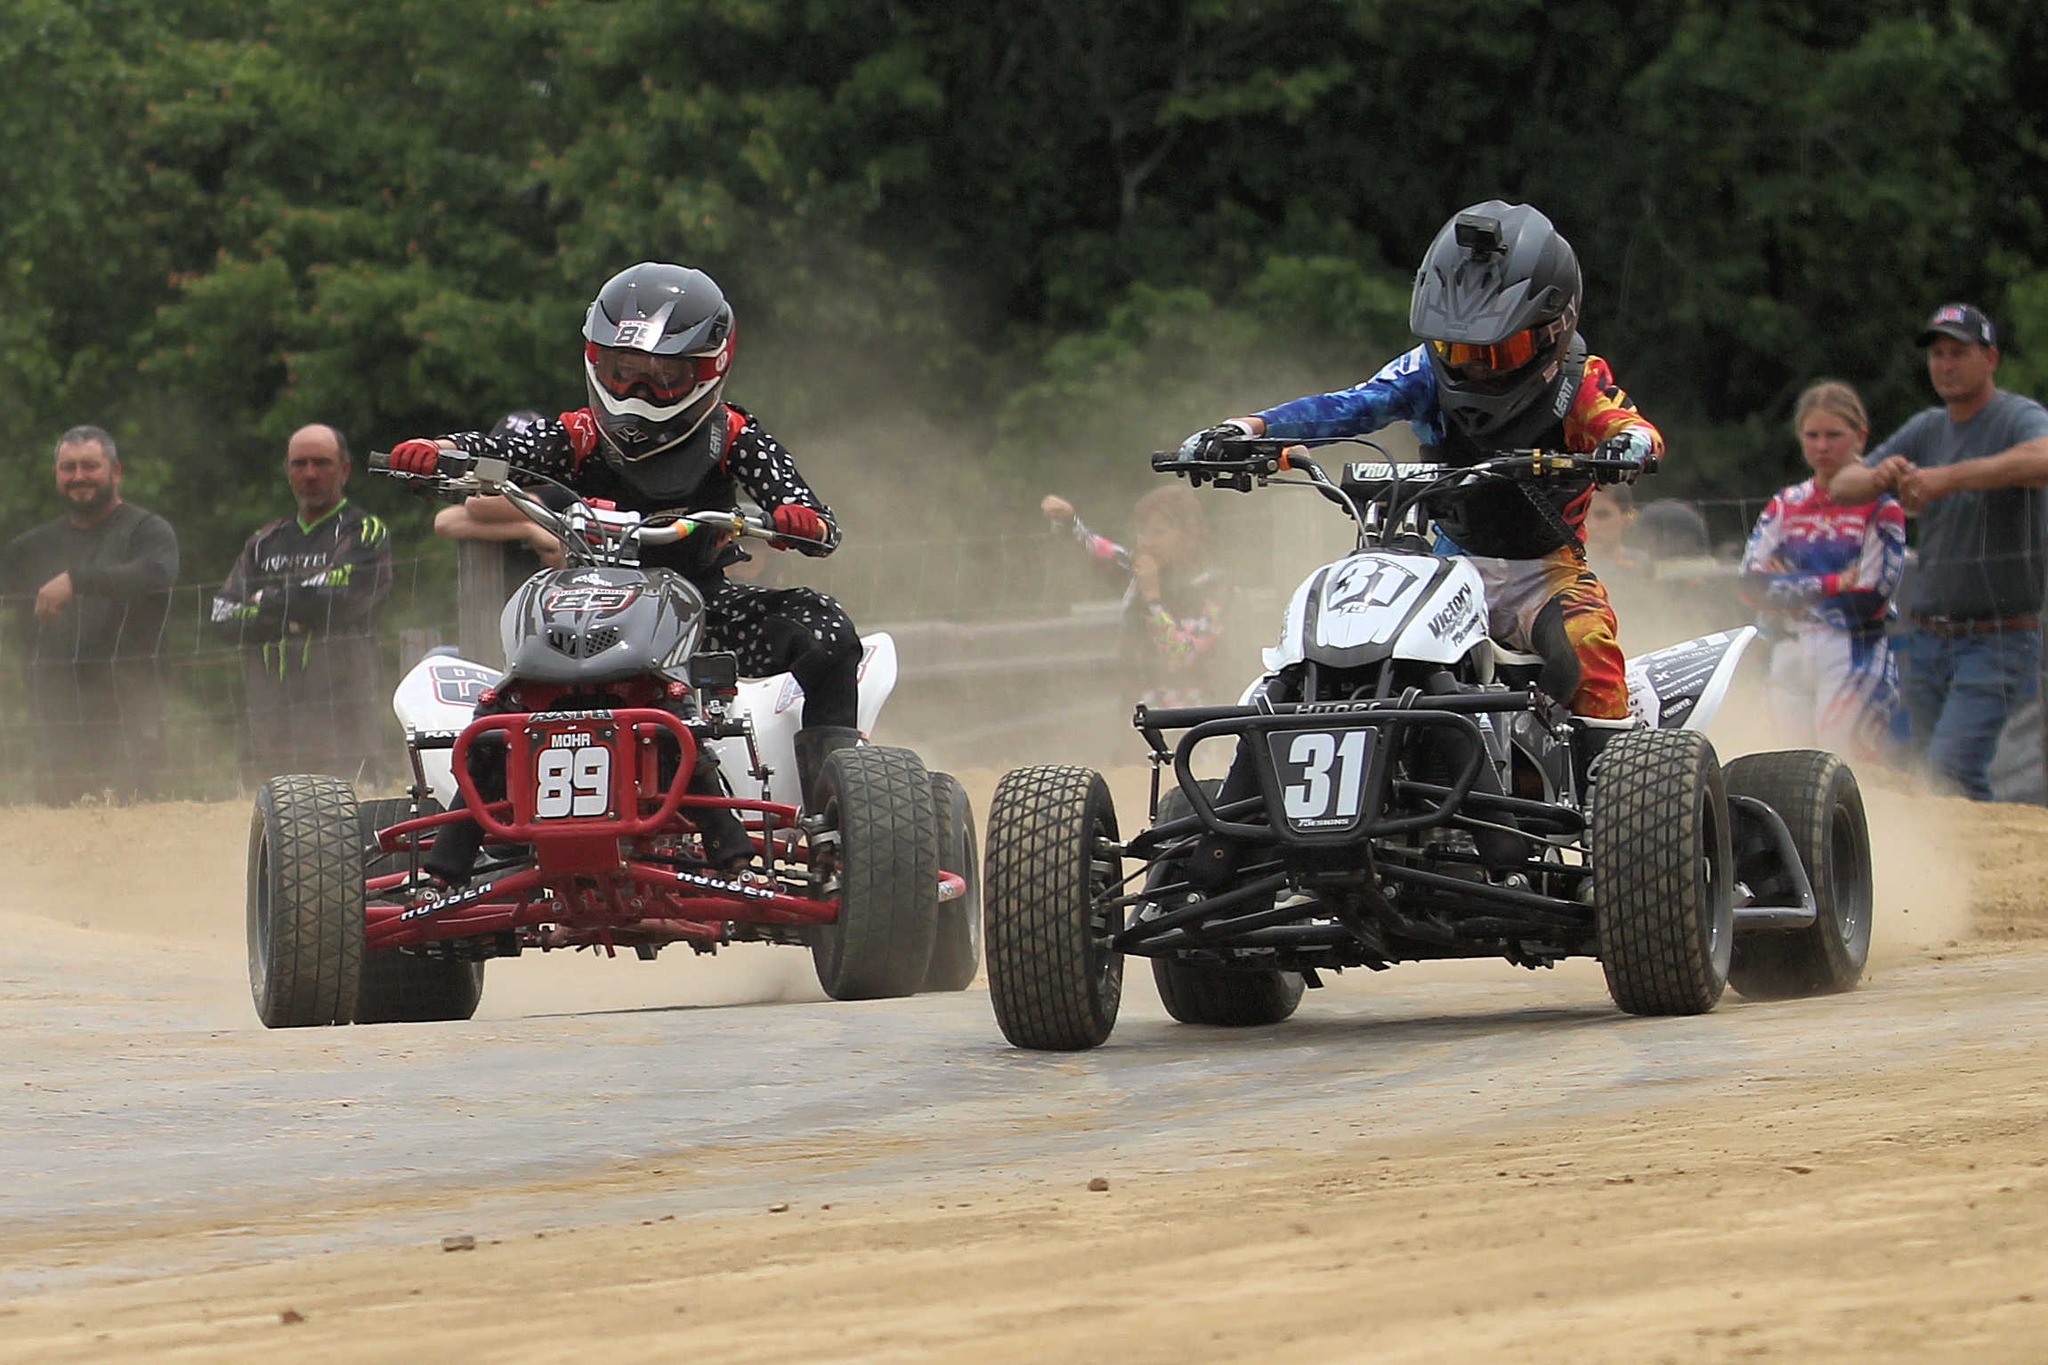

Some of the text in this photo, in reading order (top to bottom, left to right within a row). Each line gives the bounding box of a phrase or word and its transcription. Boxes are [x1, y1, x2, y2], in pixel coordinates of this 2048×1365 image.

[1328, 560, 1409, 608] 31
[551, 733, 591, 748] MOHR
[537, 746, 610, 818] 89
[1284, 731, 1367, 818] 31
